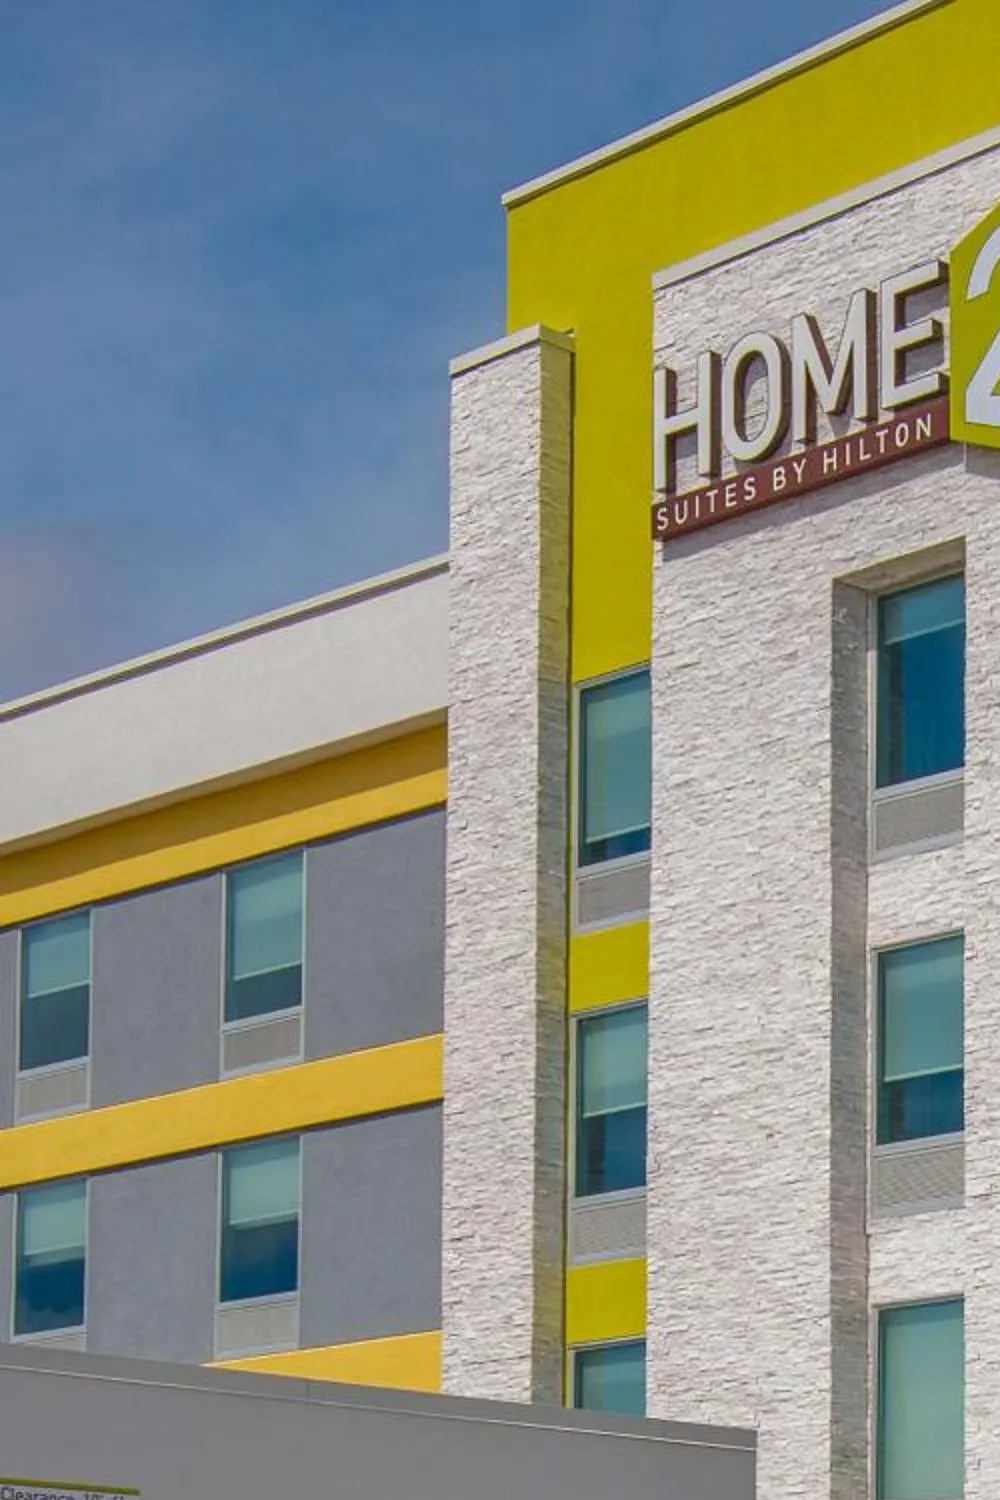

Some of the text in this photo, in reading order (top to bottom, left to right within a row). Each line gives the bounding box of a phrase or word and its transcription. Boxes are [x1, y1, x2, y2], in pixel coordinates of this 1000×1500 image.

[653, 259, 948, 491] HOME
[656, 413, 933, 532] SUITES BY HILTON
